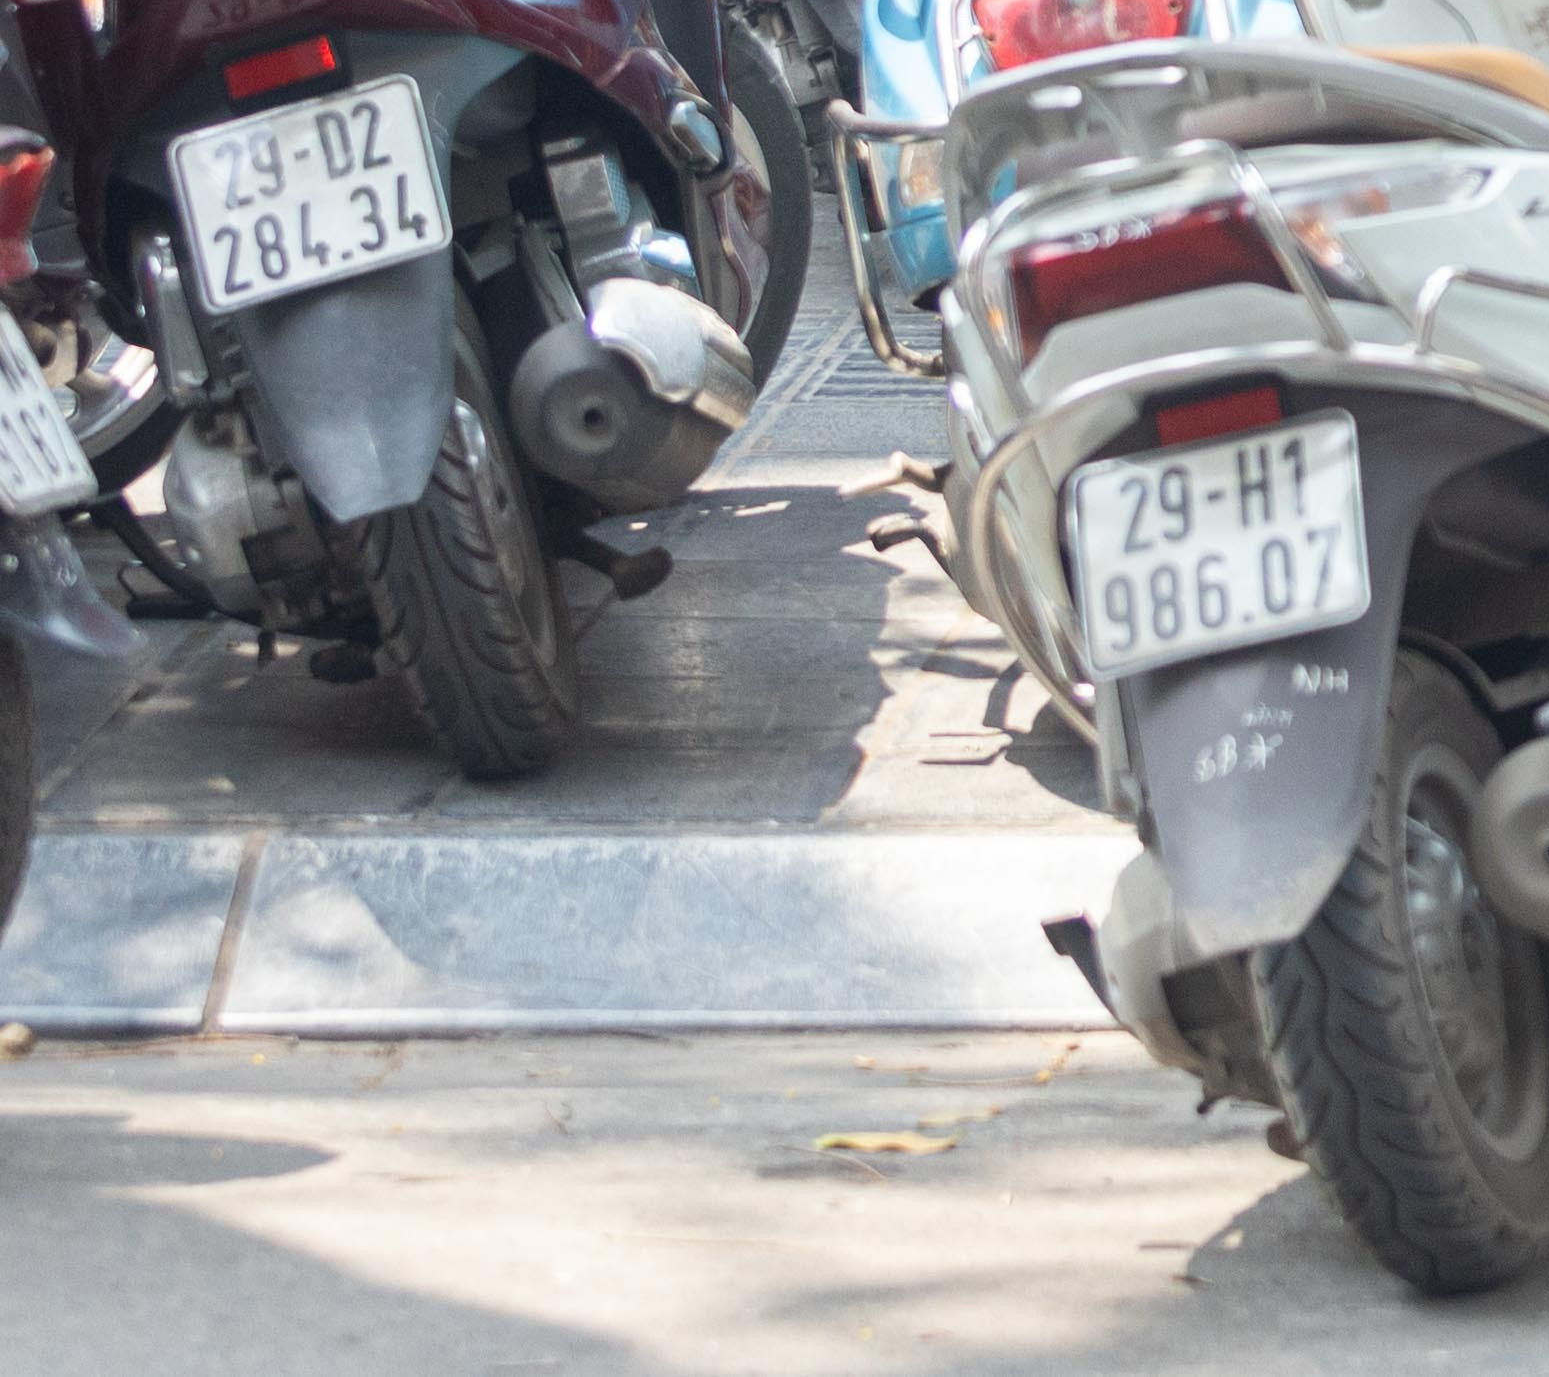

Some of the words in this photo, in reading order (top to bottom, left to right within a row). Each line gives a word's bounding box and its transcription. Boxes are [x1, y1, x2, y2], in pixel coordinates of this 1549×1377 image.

[215, 100, 392, 210] 29-D2
[212, 184, 429, 297] 284.34
[1117, 436, 1308, 558] 29-H1
[1103, 523, 1343, 652] 986.07
